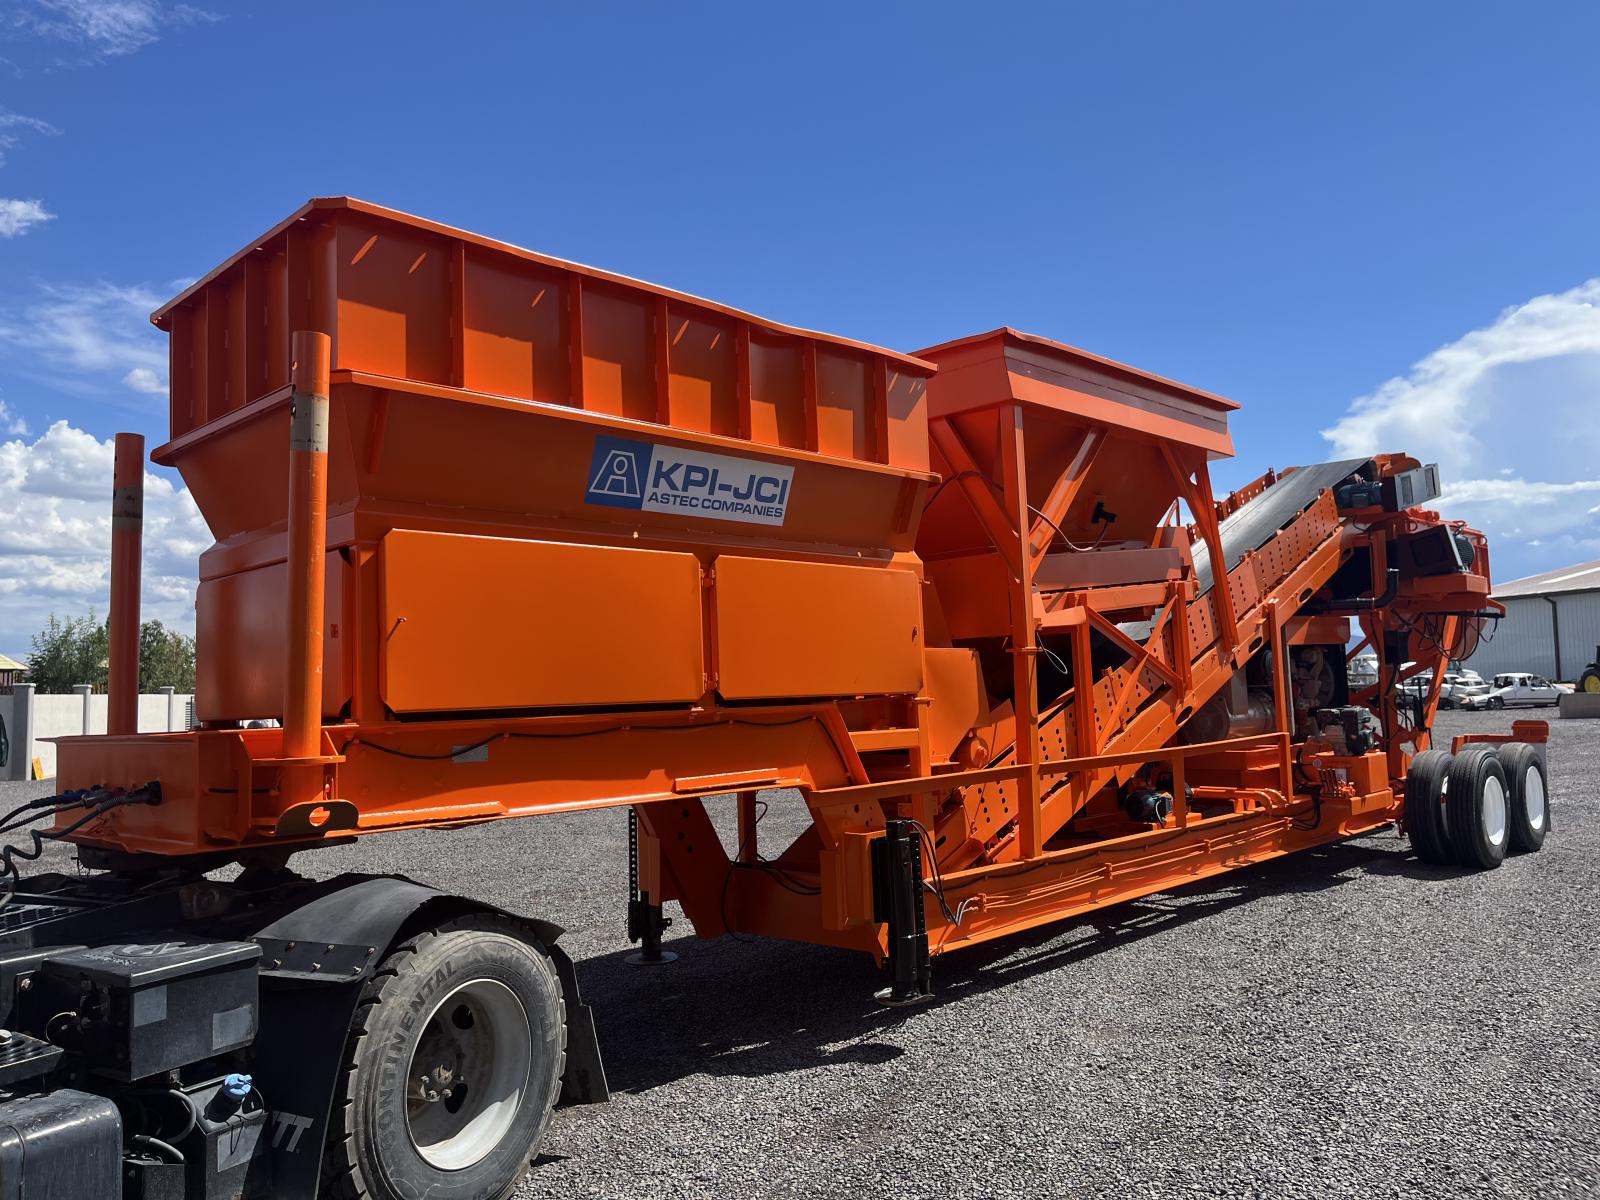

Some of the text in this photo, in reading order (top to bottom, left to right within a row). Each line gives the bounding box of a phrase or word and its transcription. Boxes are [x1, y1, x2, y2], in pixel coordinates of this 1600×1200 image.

[653, 461, 788, 504] KPI-JCI
[648, 492, 783, 518] ASTEC COMPANIES
